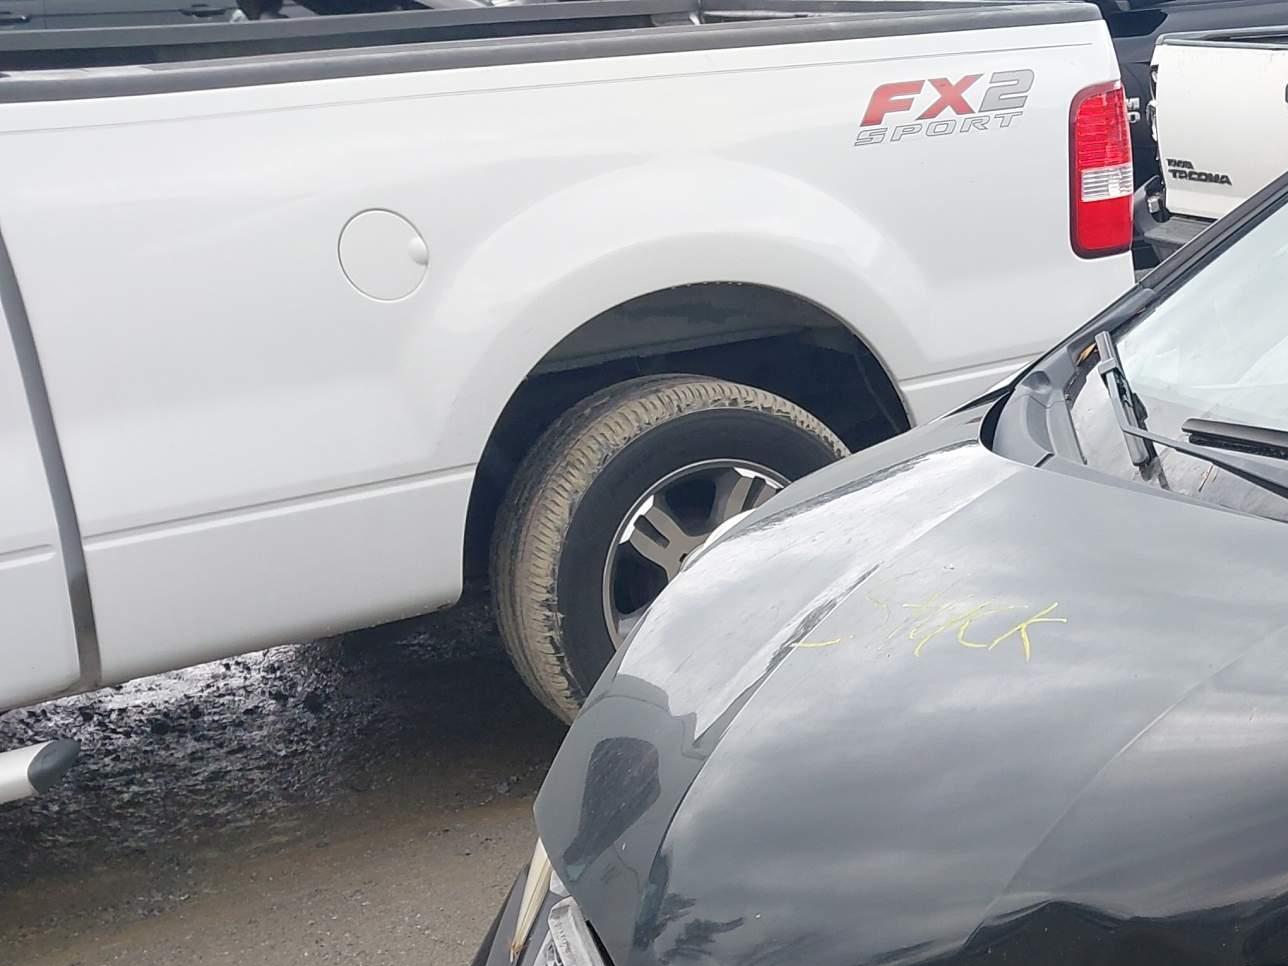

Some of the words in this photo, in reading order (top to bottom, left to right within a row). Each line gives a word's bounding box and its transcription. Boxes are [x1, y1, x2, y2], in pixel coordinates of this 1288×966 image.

[860, 69, 1035, 127] FX2
[854, 111, 1023, 147] SPORT
[1168, 169, 1232, 186] TACOMA
